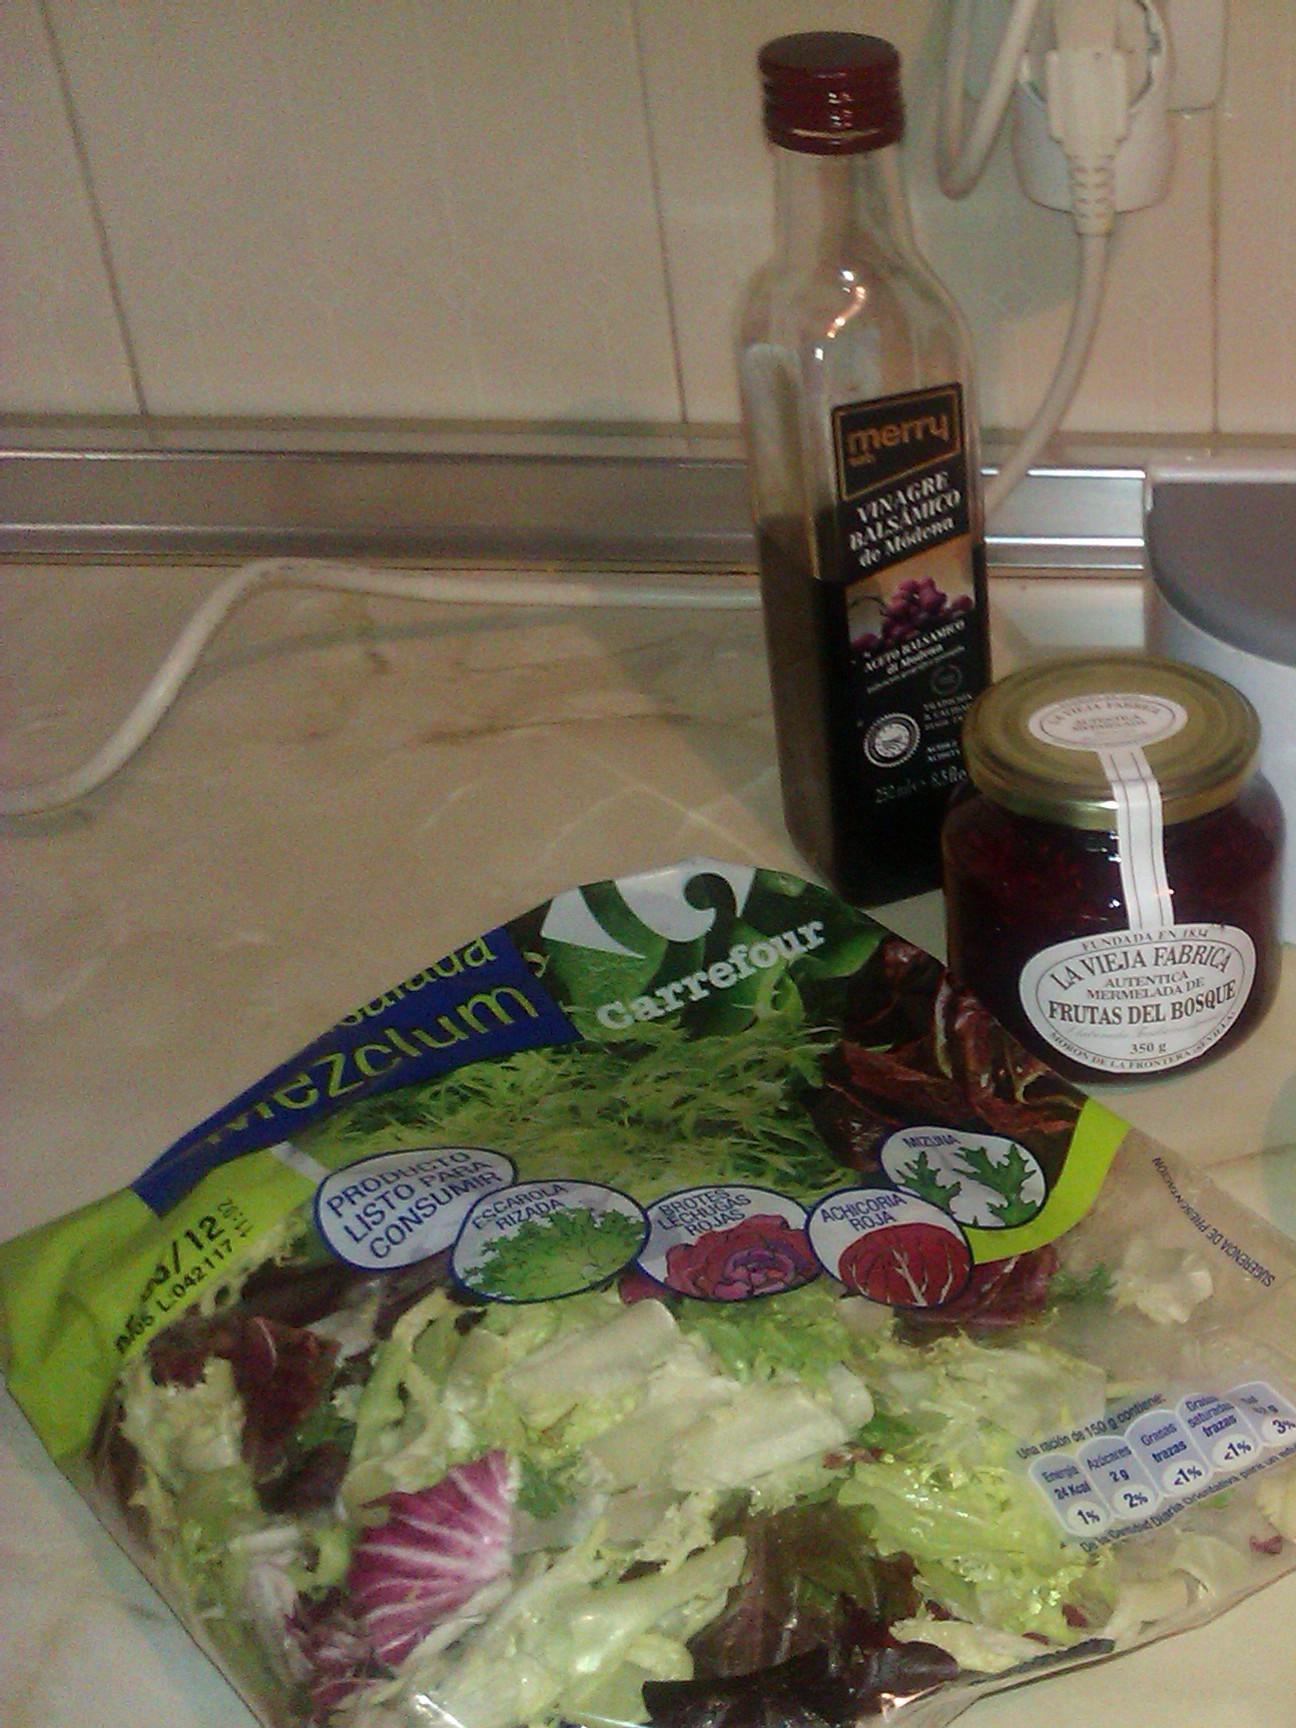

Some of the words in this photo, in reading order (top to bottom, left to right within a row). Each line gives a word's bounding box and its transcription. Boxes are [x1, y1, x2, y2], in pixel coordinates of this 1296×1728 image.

[857, 472, 949, 522] VINAGRE
[850, 489, 961, 550] BALSAMICO
[1082, 931, 1152, 951] FUNDADA
[1158, 930, 1177, 942] EN
[1050, 966, 1083, 991] LA
[1081, 949, 1147, 974] VIEJA
[1153, 944, 1232, 973] FABRICA
[1104, 970, 1190, 989] AUTENTICA
[1087, 984, 1182, 1000] MERMELADA
[1186, 977, 1205, 992] DE
[1048, 1001, 1122, 1025] FRUTAS
[1128, 1003, 1166, 1025] DEL
[1171, 979, 1236, 1021] BOSQUE
[1130, 1043, 1154, 1055] 350
[1158, 1042, 1167, 1054] g
[902, 1134, 960, 1148] MIZUNA
[327, 1152, 470, 1218] PRODUCTO
[343, 1184, 415, 1243] LISTO
[420, 1161, 492, 1188] PARA
[370, 1171, 502, 1258] CONSUMIR
[472, 1184, 568, 1230] ESCAROLA
[496, 1198, 566, 1230] RIZADA
[658, 1194, 751, 1230] LECHUGAS
[659, 1189, 730, 1216] BROTES
[820, 1194, 907, 1222] ACHICORIA
[684, 1209, 745, 1236] ROJAS
[849, 1211, 896, 1231] ROJA
[1206, 1228, 1224, 1245] DE
[1220, 1239, 1275, 1287] SUGERENCIA
[1084, 1420, 1108, 1439] 150
[1140, 1421, 1177, 1447] Grasas
[1202, 1415, 1238, 1438] trazas
[1272, 1419, 1296, 1435] 3%
[1151, 1440, 1188, 1464] trazas
[1223, 1440, 1253, 1462] <1%
[1173, 1465, 1203, 1488] <1%
[1123, 1491, 1149, 1509] 2%
[1076, 1509, 1102, 1526] 1%
